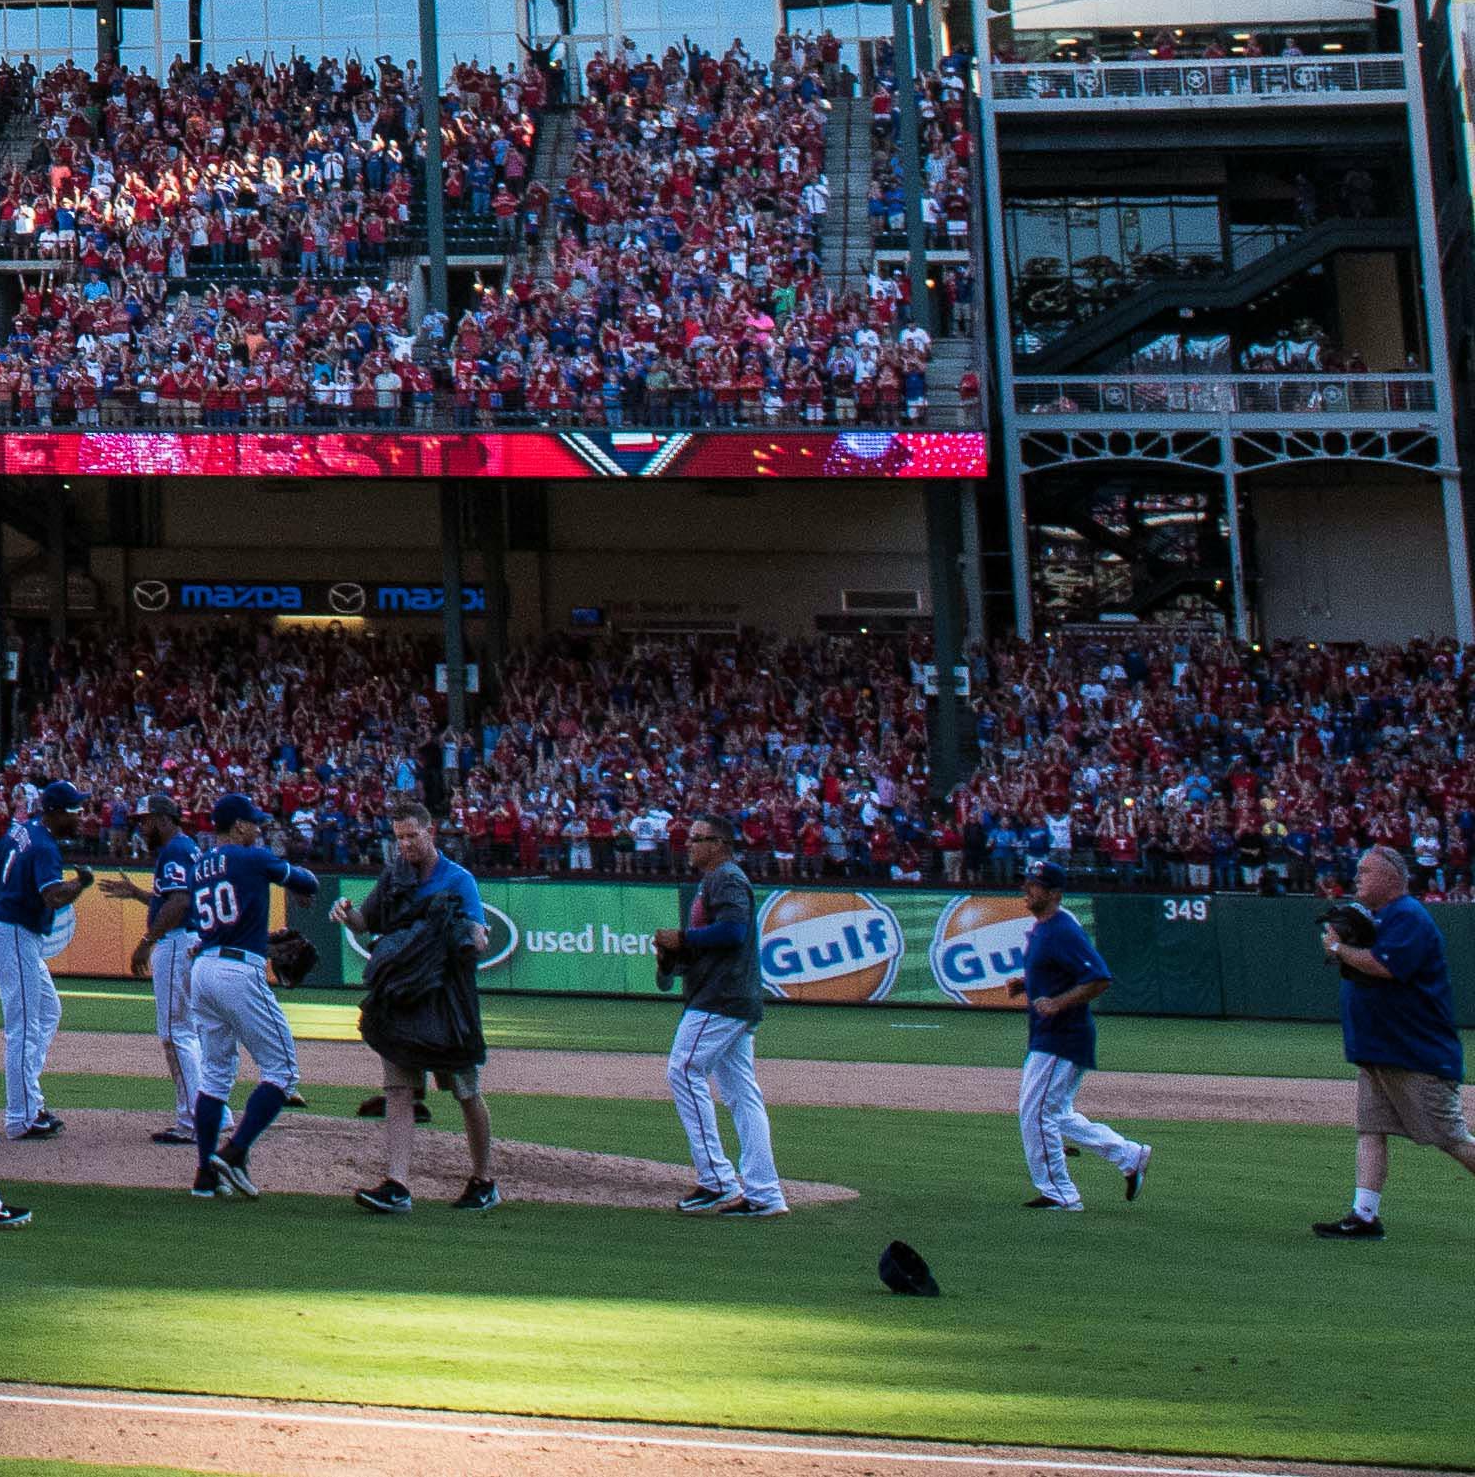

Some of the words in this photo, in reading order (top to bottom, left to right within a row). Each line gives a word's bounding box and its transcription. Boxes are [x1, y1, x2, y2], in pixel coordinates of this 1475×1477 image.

[180, 584, 302, 609] mazda
[1, 849, 16, 885] 1
[195, 853, 227, 882] KELA
[194, 880, 239, 931] 50
[1163, 899, 1207, 921] 349
[526, 924, 594, 954] used
[761, 918, 888, 977] Gulf
[941, 934, 1027, 983] Gu
